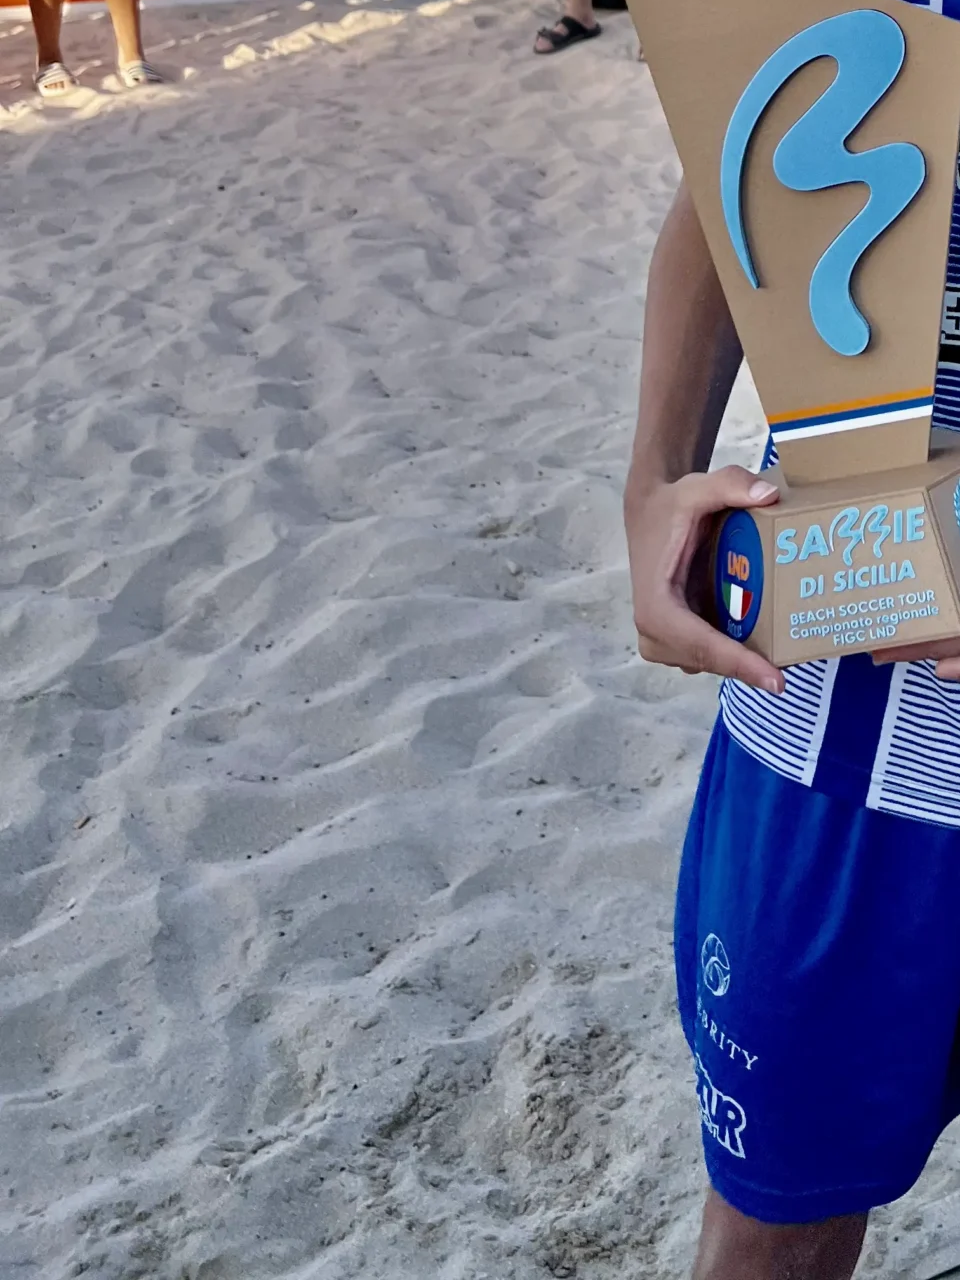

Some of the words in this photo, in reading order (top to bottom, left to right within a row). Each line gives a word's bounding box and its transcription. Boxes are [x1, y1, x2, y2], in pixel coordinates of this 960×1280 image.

[727, 550, 750, 581] LND
[800, 574, 824, 598] DI
[833, 560, 915, 592] SICILIA
[790, 607, 835, 625] BEACH
[838, 596, 895, 617] SOCCER
[898, 589, 935, 606] TOUR
[790, 616, 873, 639] Campionato
[876, 605, 939, 625] regionale
[833, 630, 866, 646] FIGC
[869, 624, 896, 640] LND
